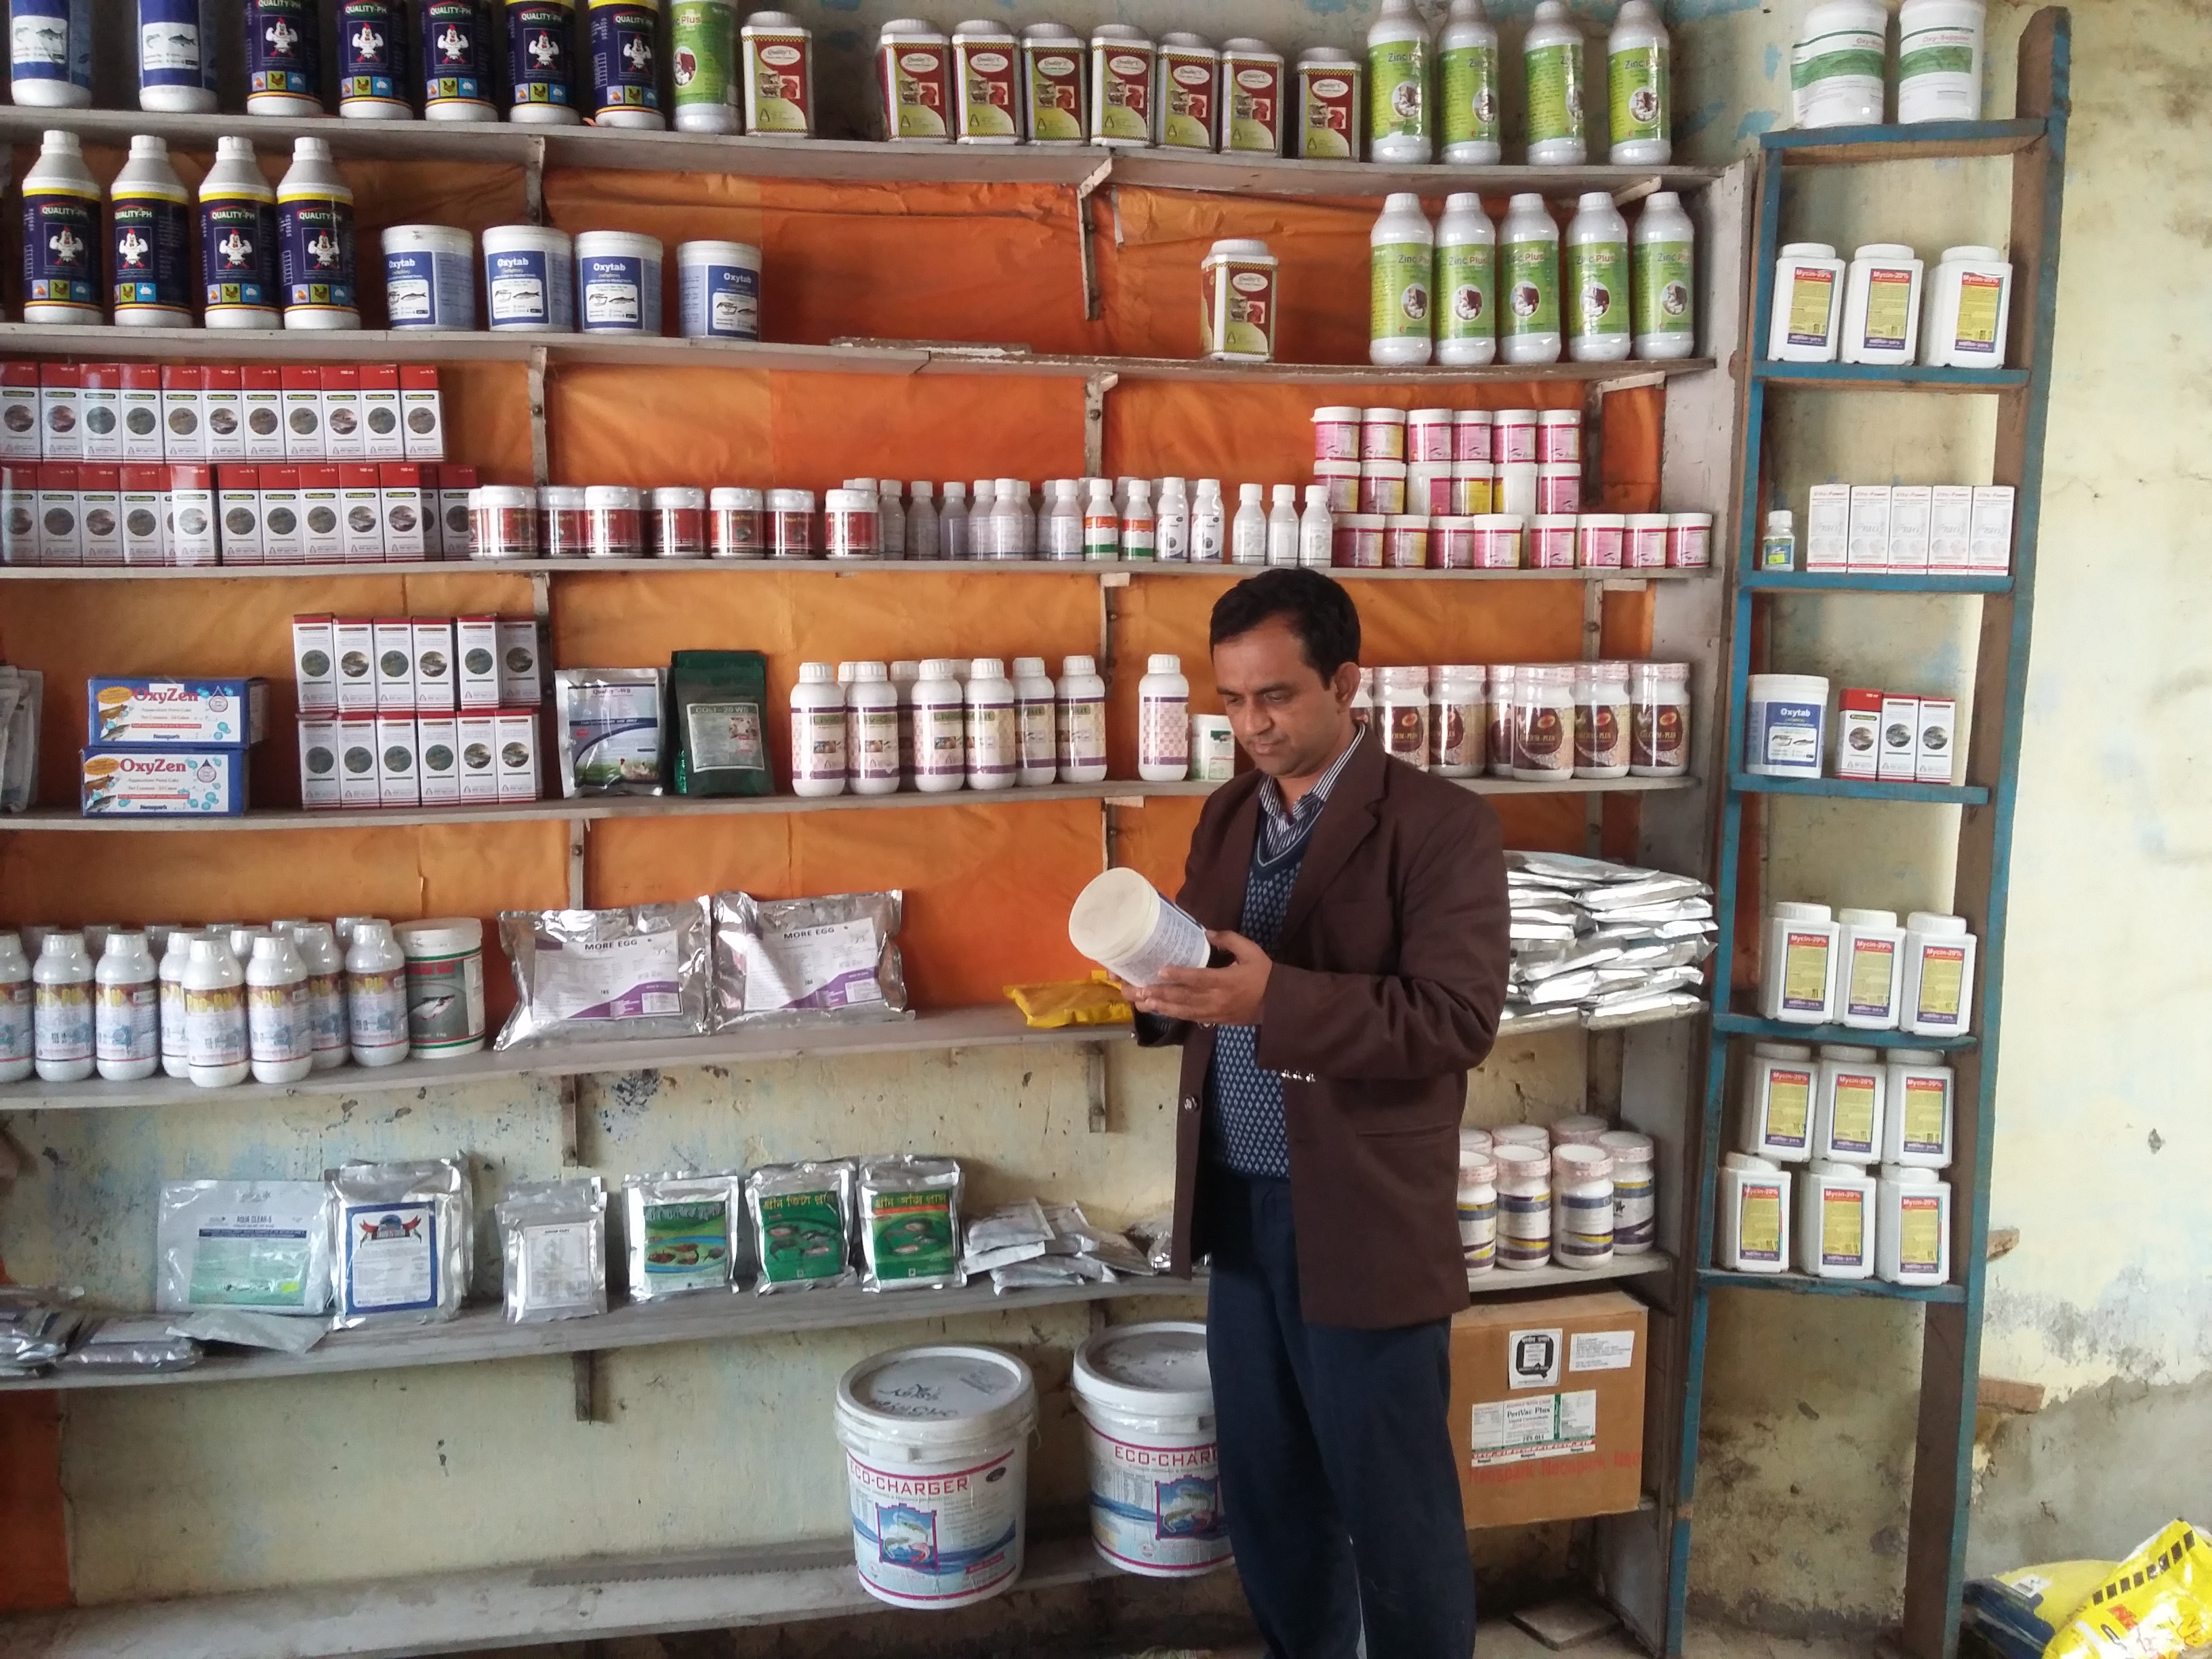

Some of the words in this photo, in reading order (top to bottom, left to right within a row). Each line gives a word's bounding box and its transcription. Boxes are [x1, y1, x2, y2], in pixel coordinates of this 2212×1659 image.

[497, 258, 529, 268] Oxytab
[1449, 256, 1469, 266] Zinc
[1525, 253, 1545, 263] Plus
[1595, 253, 1614, 264] Plus
[593, 262, 626, 272] Oxytab
[724, 272, 752, 285] Oxytab
[134, 688, 199, 704] OxyZen
[1780, 707, 1811, 718] Oxytab
[120, 758, 186, 775] OxyZen
[783, 929, 812, 940] MORE
[815, 926, 835, 936] EGG
[1790, 934, 1826, 944] Mycin-20%
[585, 941, 614, 951] MORE
[617, 939, 638, 947] EGG
[1115, 1444, 1217, 1467] ECO-CHAR
[850, 1459, 968, 1496] ECO-CHARGER
